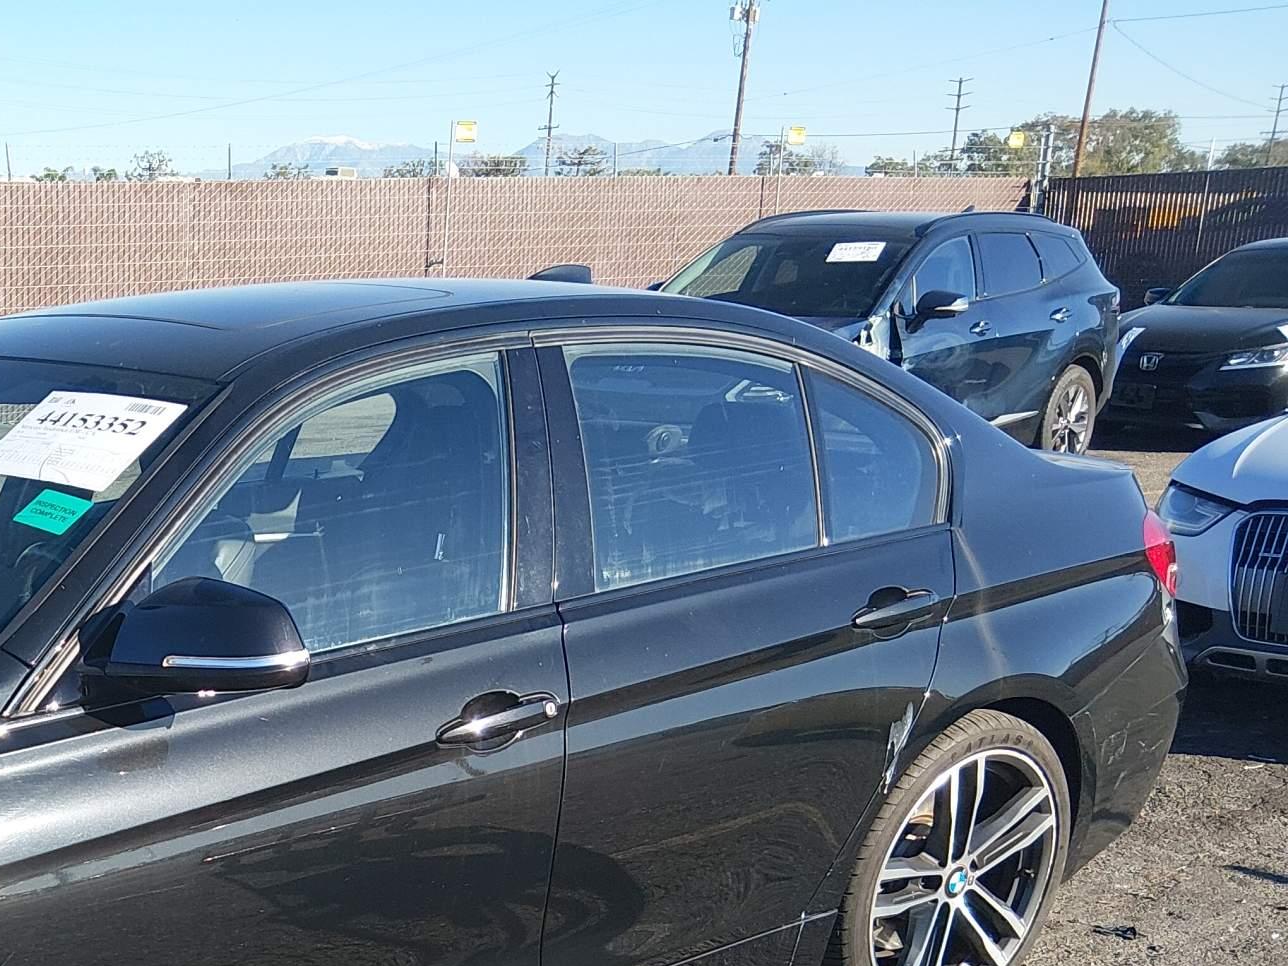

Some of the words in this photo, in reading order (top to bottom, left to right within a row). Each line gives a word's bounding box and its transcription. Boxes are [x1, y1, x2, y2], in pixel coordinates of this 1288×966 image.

[37, 411, 148, 436] 44153352
[31, 508, 69, 523] COMPLETE
[37, 501, 78, 516] INSPECTION
